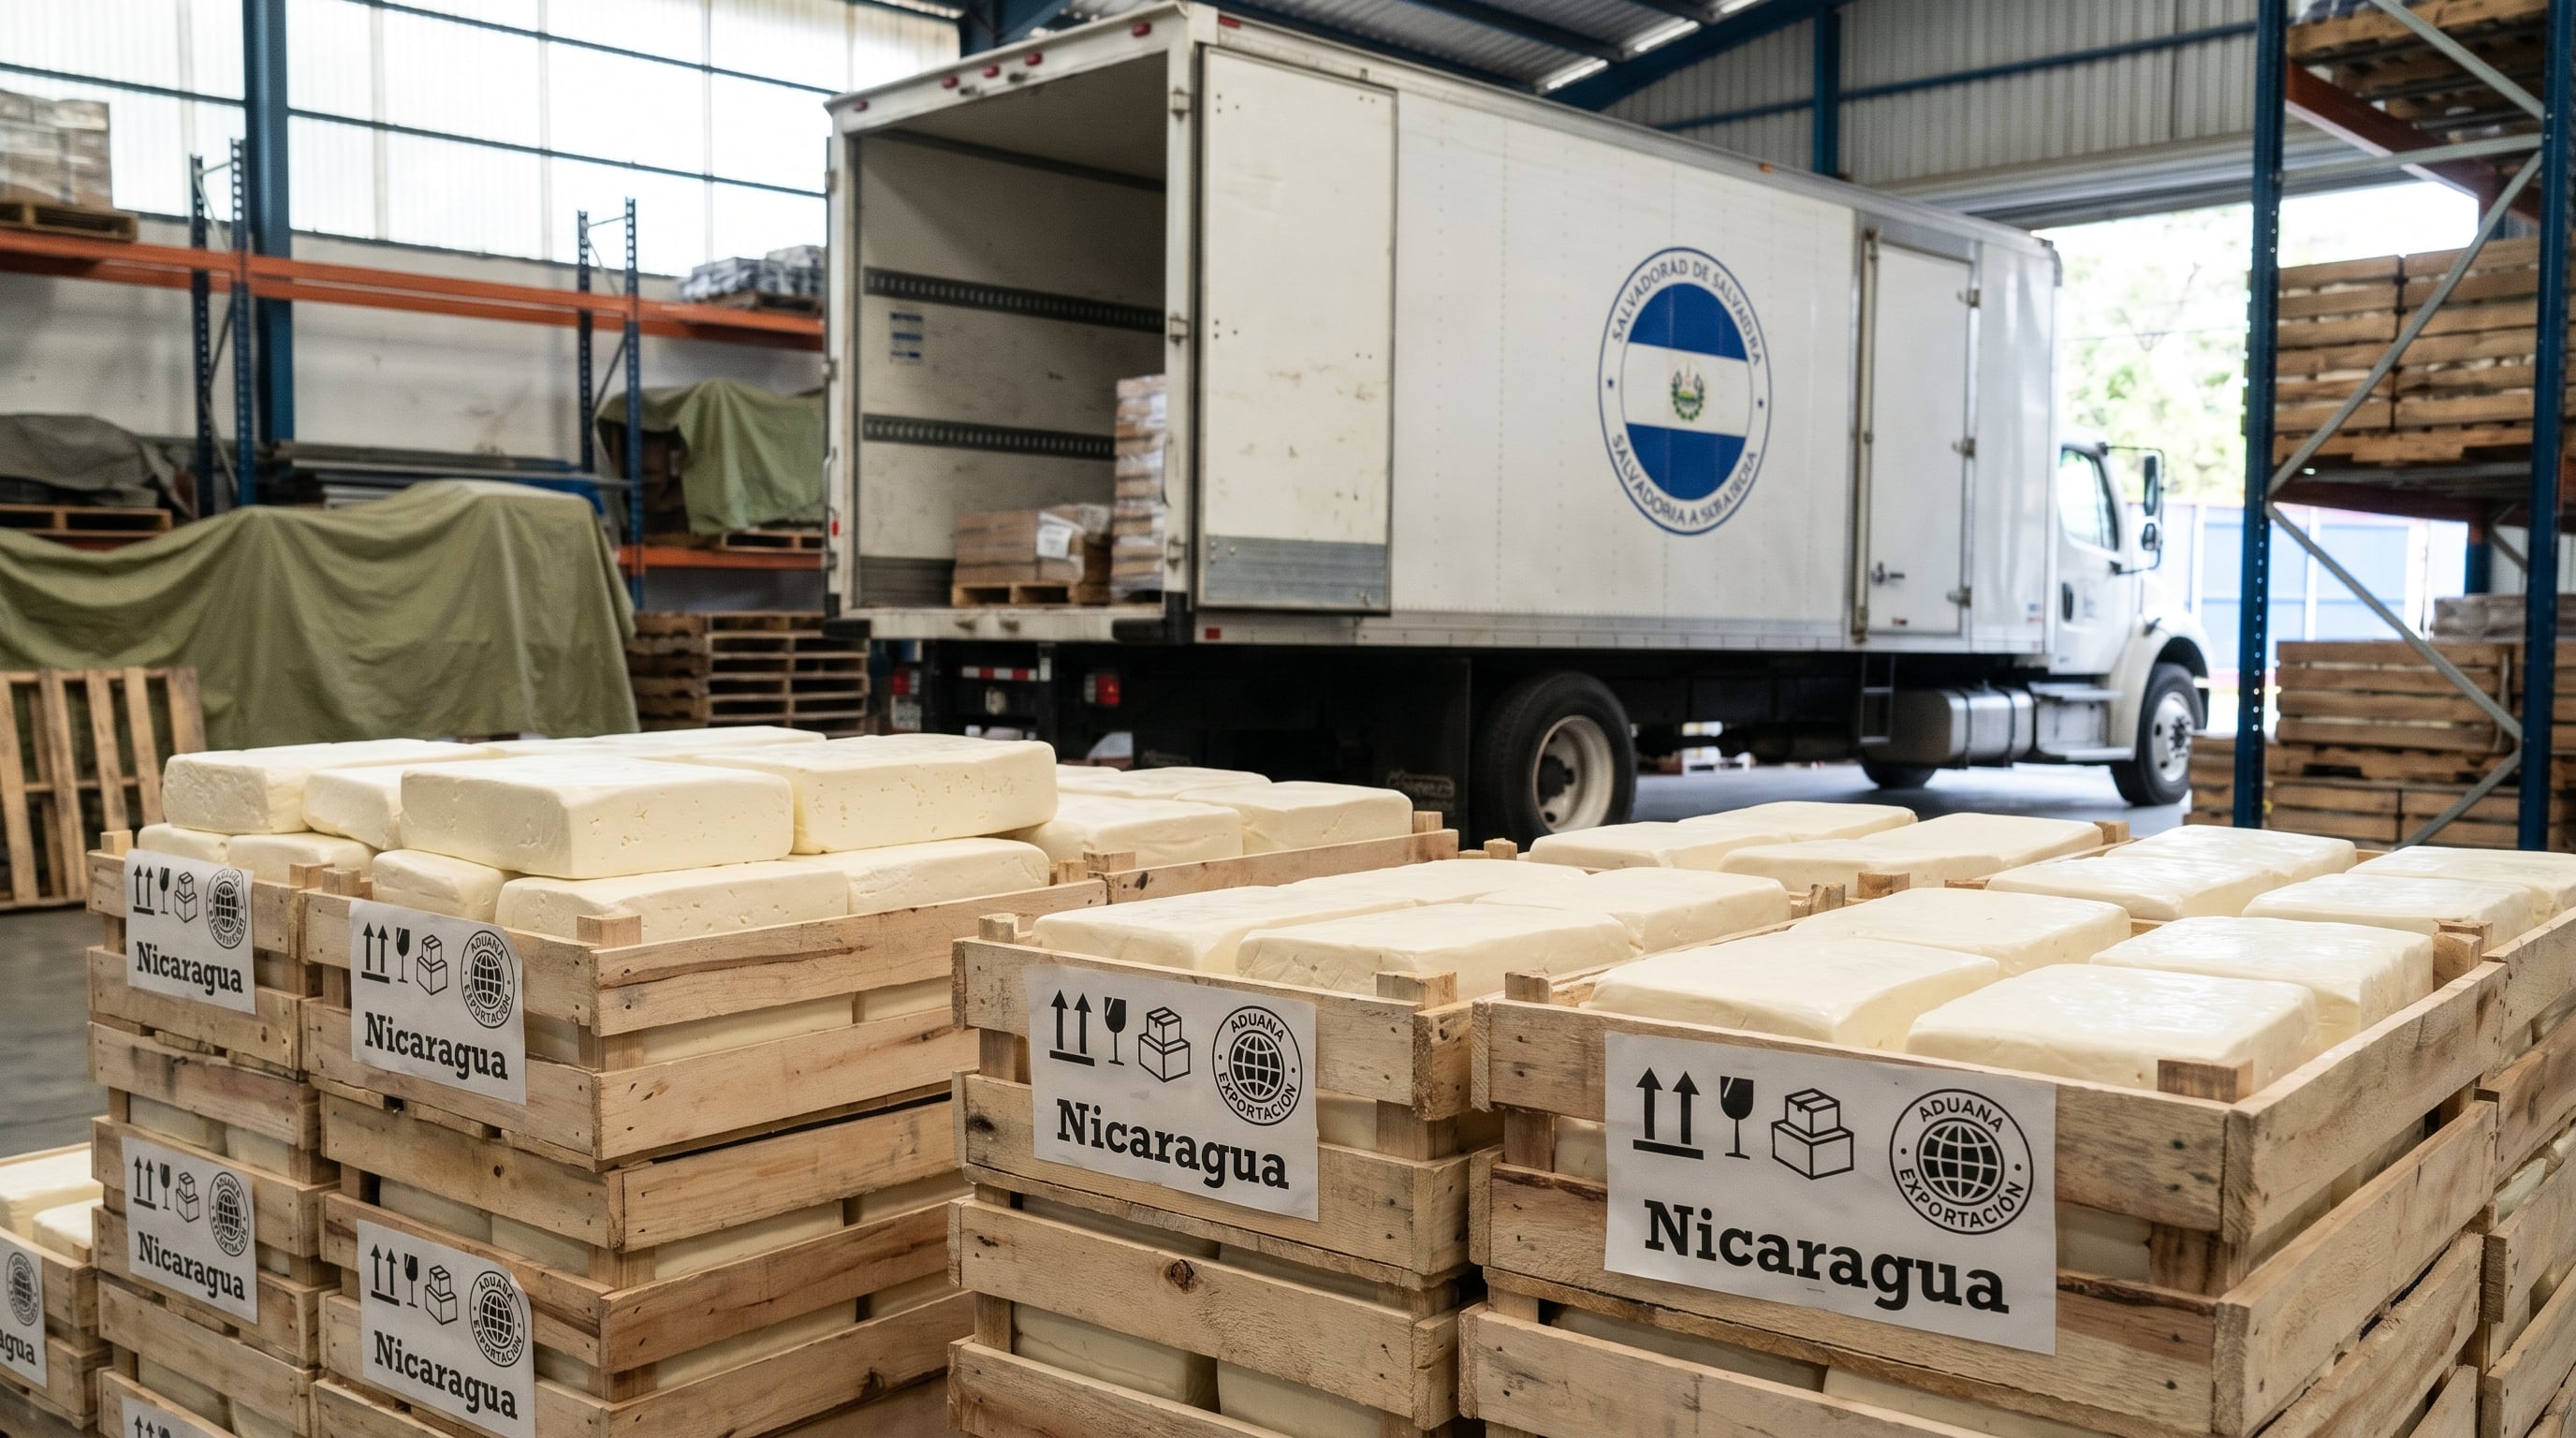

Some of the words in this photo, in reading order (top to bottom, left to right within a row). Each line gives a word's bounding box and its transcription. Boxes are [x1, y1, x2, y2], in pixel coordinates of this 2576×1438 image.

[1612, 257, 1688, 342] SALVADORAD
[1692, 261, 1709, 281] DE
[137, 941, 243, 996] Nicaragua
[471, 935, 505, 961] ADUANA
[365, 1011, 508, 1080] Nicaragua
[1230, 1013, 1284, 1042] ADUANA
[1057, 1098, 1289, 1189] Nicaragua
[1919, 1097, 2004, 1133] ADUANA
[1899, 1168, 2025, 1228] EXPORTACIÓN
[138, 1230, 245, 1300] Nicaragua
[1644, 1199, 2010, 1314] Nicaragua
[479, 1276, 514, 1302] ADUANA
[373, 1329, 519, 1420] Nicaragua
